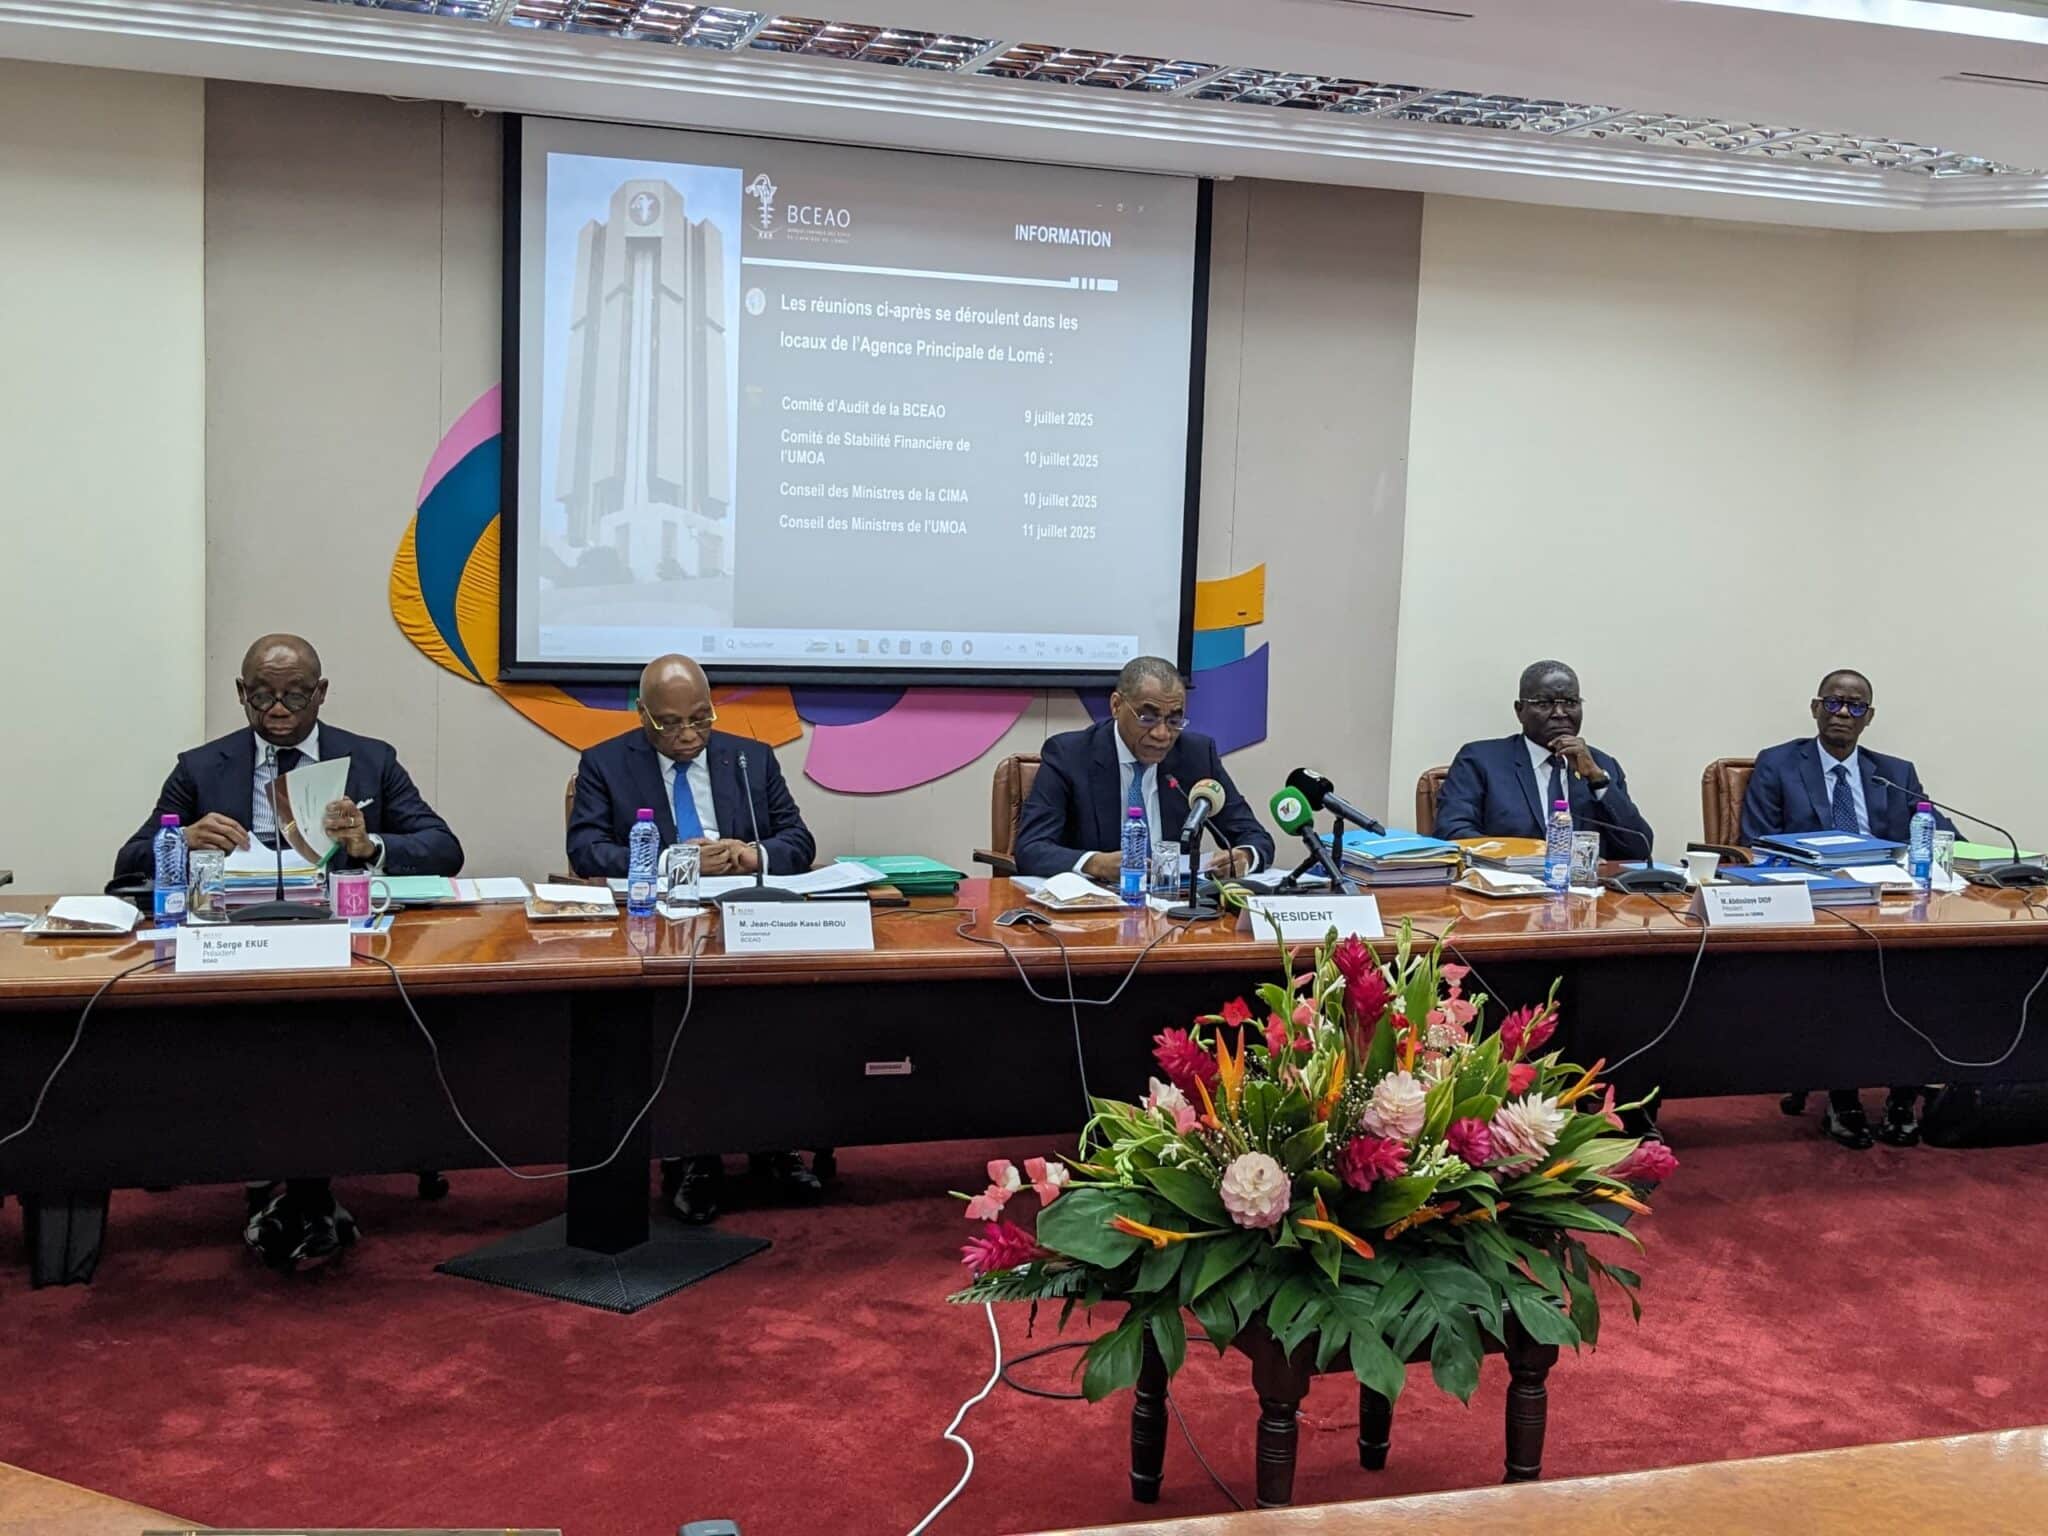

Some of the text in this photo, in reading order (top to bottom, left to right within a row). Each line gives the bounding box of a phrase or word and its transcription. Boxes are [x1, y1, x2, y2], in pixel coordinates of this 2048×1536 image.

[787, 204, 850, 228] BCEAO
[1015, 224, 1112, 248] INFORMATION
[780, 293, 1079, 330] Les réunions ci-après se déroulent dans les
[780, 331, 827, 350] locaux
[831, 335, 848, 351] de
[852, 335, 912, 357] l'Agence
[916, 340, 984, 362] Principale
[988, 344, 1004, 361] de
[1008, 345, 1045, 364] Lomé
[782, 395, 946, 419] Comité d'Audit de la BCEAO
[1024, 410, 1094, 427] 9 juillet 2025
[781, 428, 970, 452] Comité de Stabilité Financière de
[780, 449, 826, 465] l'UMOA
[1023, 451, 1099, 468] 10 juillet 2025
[780, 481, 969, 503] Conseil des Ministres de la CIMA
[1023, 491, 1097, 509] 10 juillet 2025
[779, 514, 968, 535] Conseil des Ministres de l'UMOA
[1022, 523, 1096, 540] 11 juillet 2025
[739, 920, 846, 928] M. Jean-Claude Kassi BROU
[1264, 911, 1334, 922] RESIDENT
[203, 939, 269, 951] M. Serge EKUE
